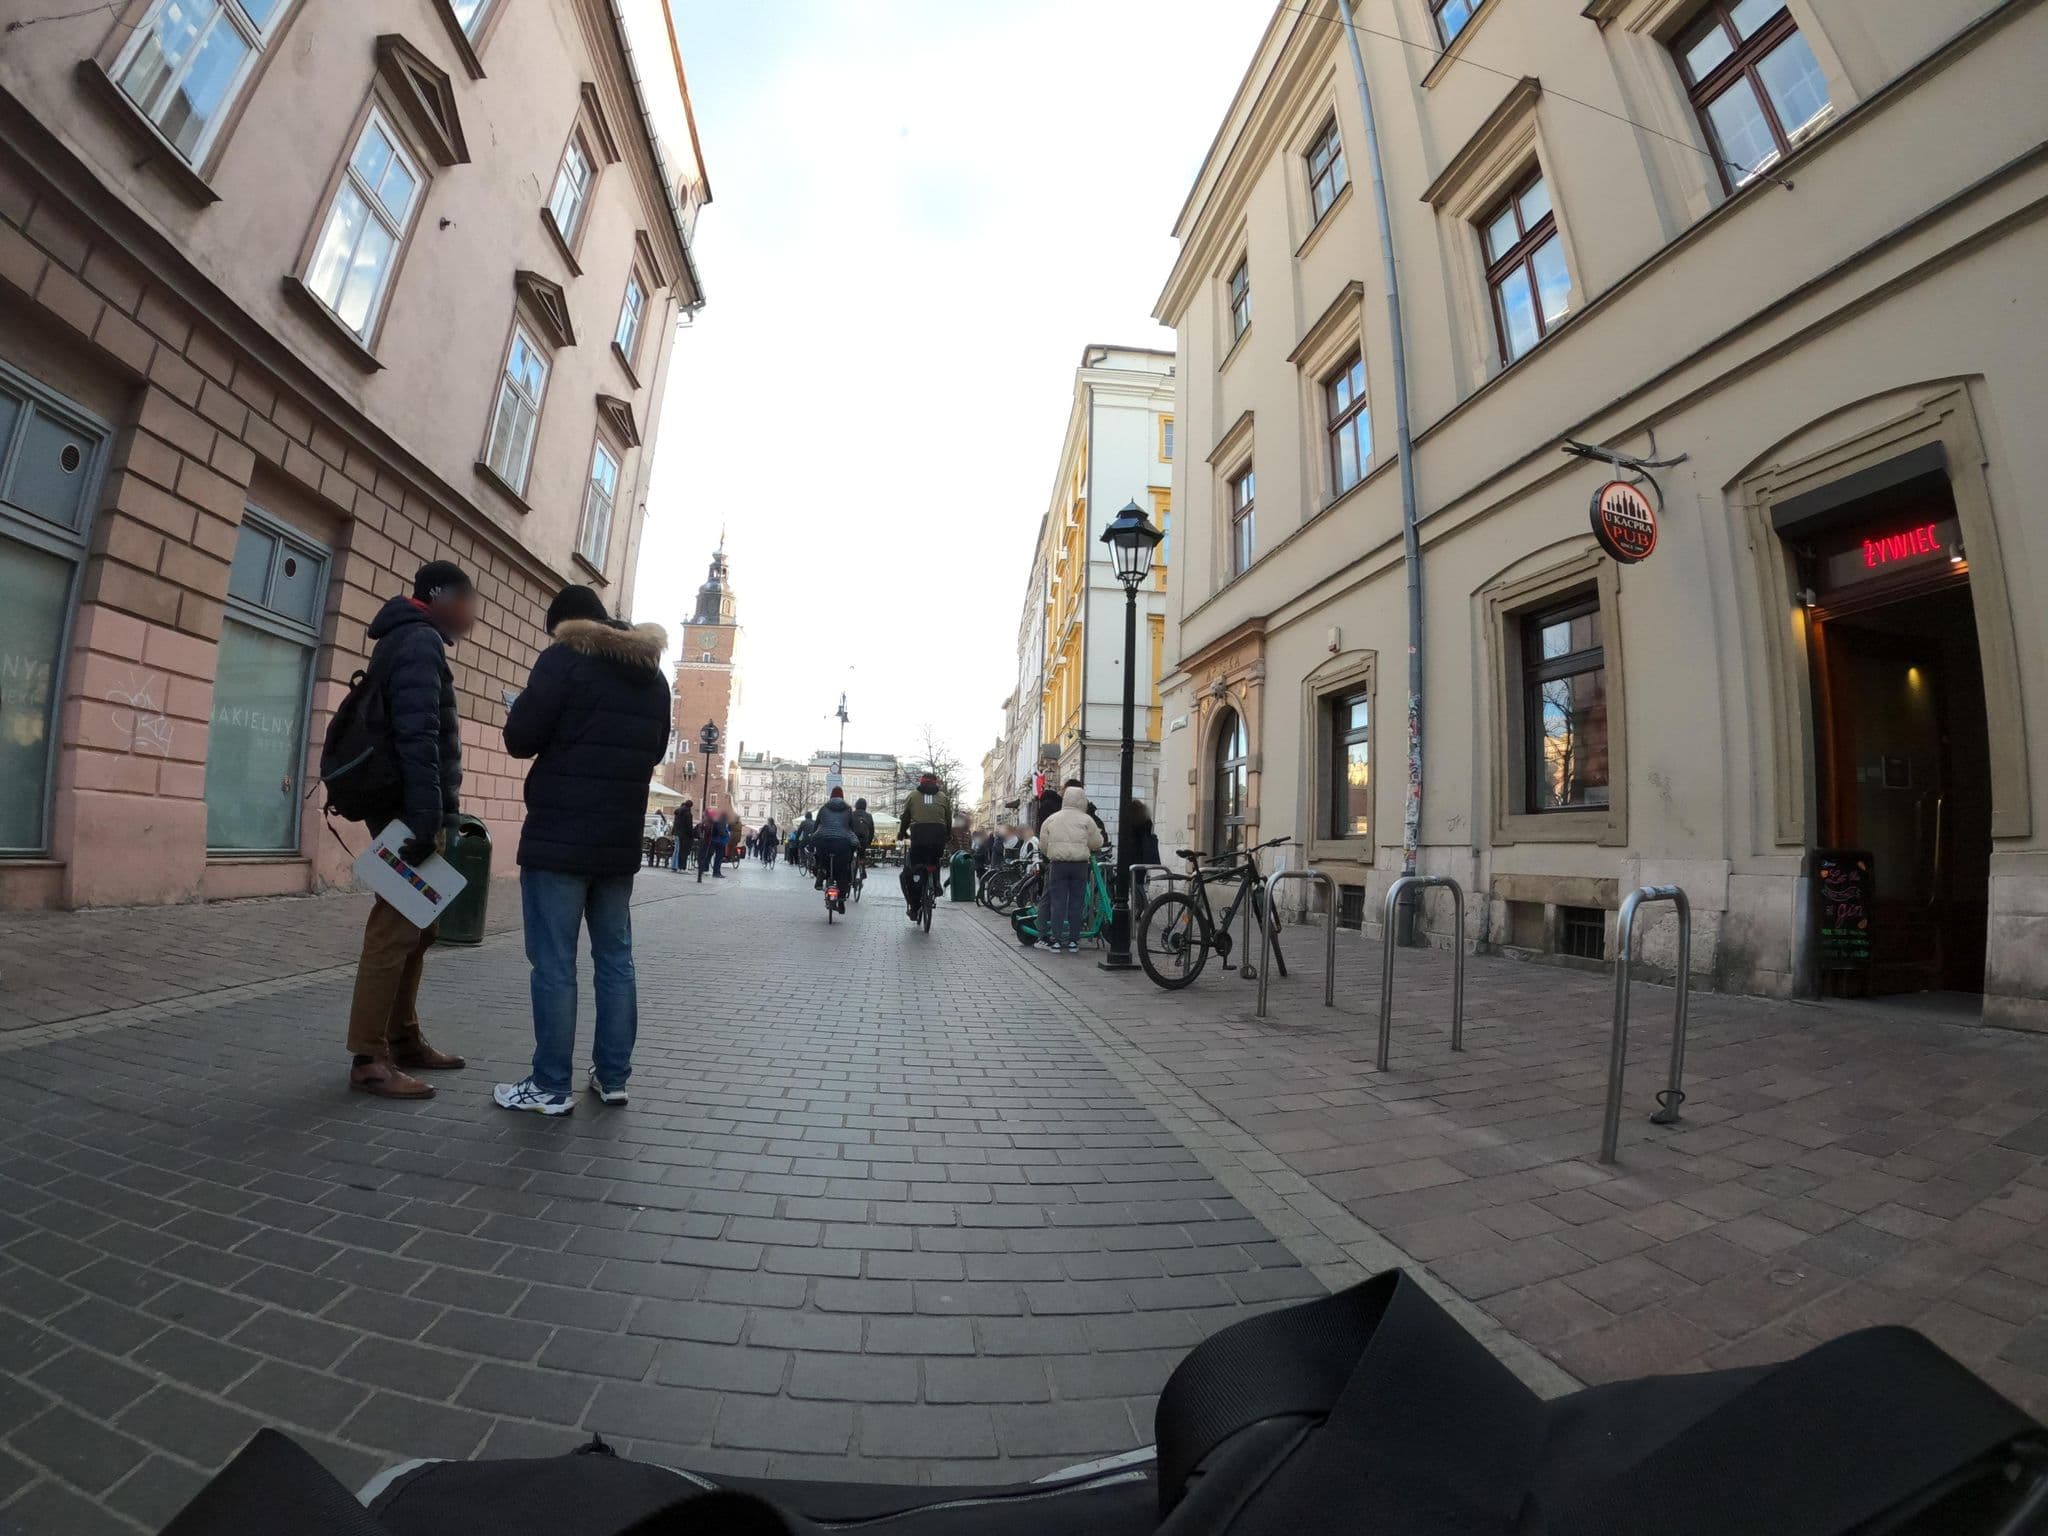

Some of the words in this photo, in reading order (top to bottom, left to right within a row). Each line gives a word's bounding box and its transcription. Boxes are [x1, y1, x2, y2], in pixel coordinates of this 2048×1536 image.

[1605, 511, 1612, 522] U
[1614, 514, 1652, 534] KACPRA
[1613, 526, 1649, 546] PUB
